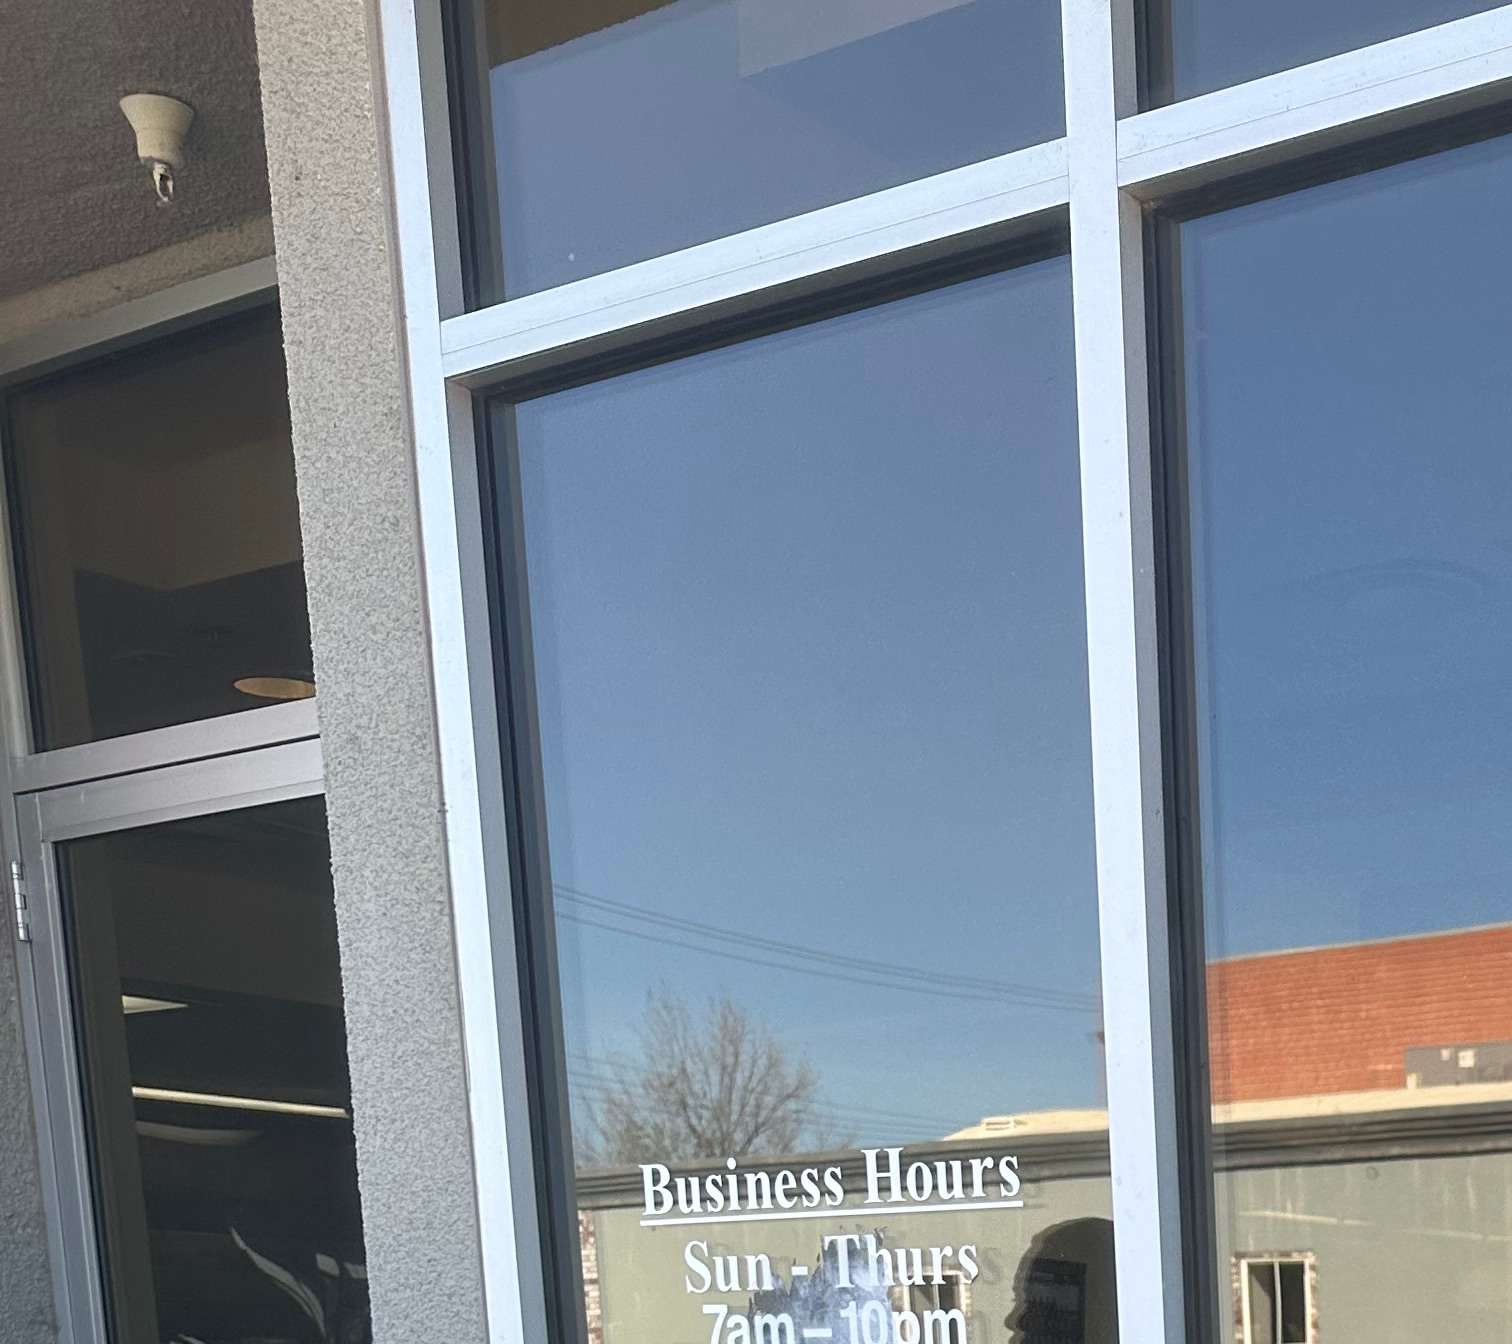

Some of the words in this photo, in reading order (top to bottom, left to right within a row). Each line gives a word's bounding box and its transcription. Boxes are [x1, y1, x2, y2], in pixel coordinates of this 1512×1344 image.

[638, 1157, 844, 1216] Business
[861, 1146, 1022, 1205] Hours
[685, 1240, 775, 1294] Sun
[824, 1233, 980, 1287] Thurs
